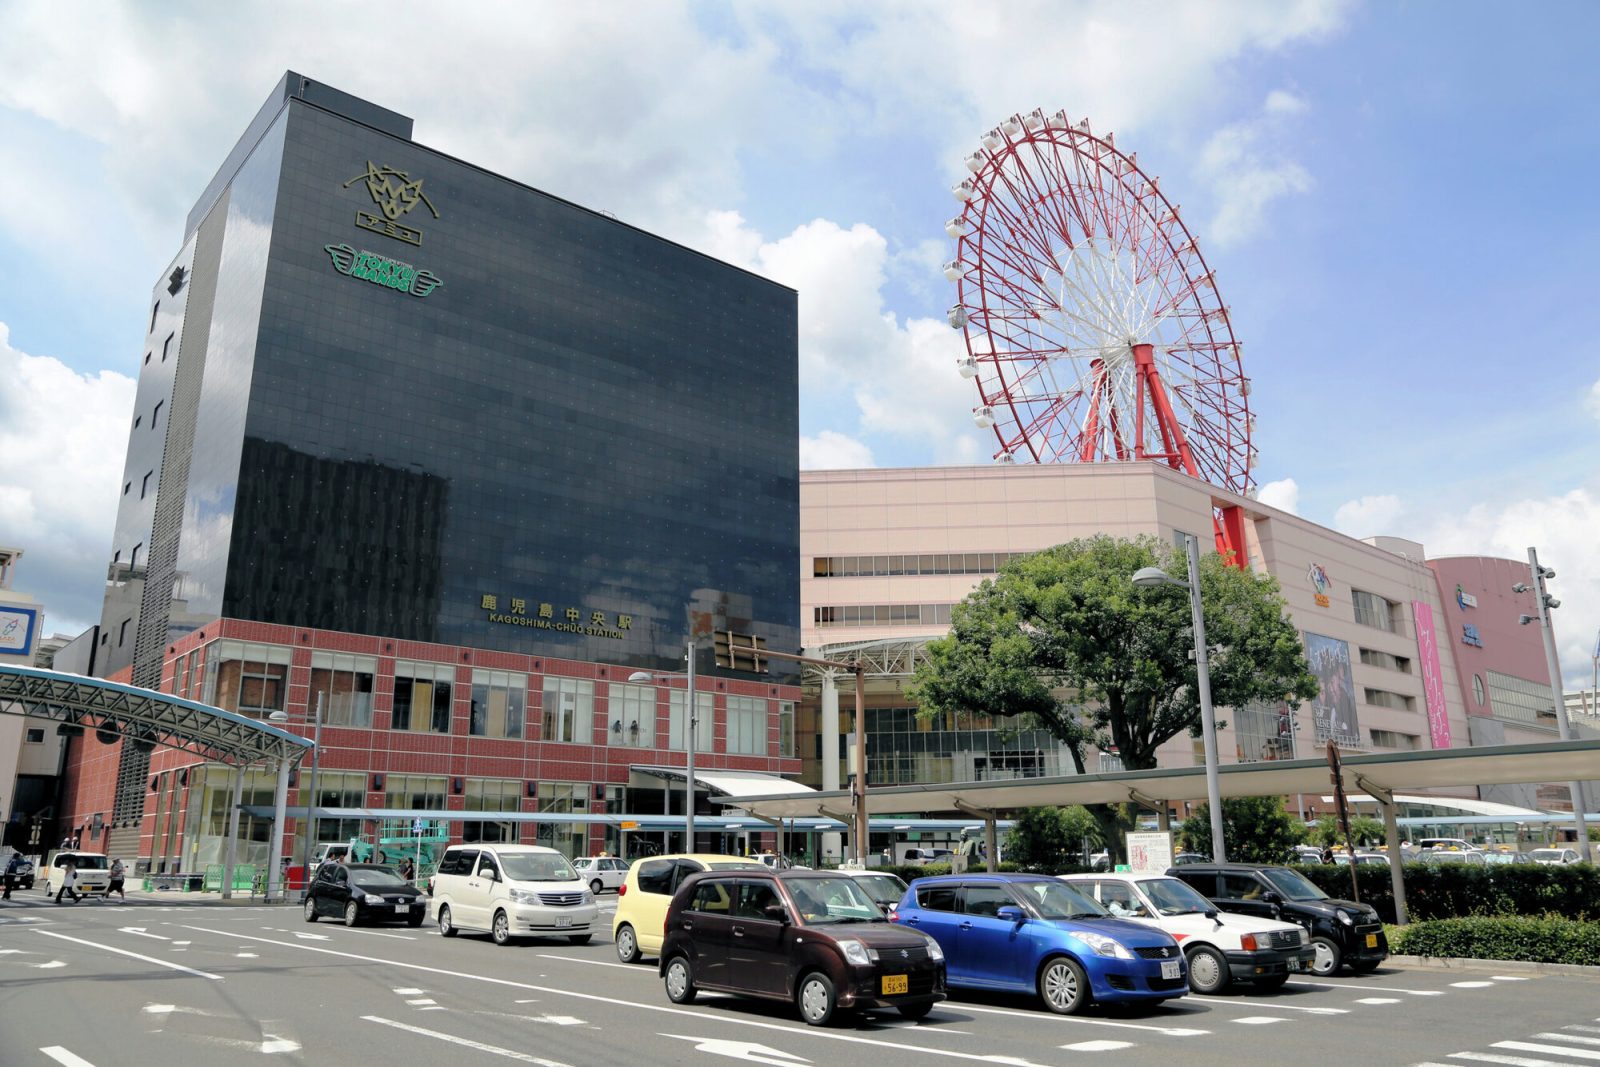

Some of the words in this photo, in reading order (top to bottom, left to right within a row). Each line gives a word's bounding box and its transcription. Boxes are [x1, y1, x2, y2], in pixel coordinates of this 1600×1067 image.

[353, 265, 411, 292] HANDS
[358, 253, 415, 281] TOKYU
[481, 594, 633, 631] 鹿児島中央駅
[585, 627, 625, 640] STATION
[887, 982, 907, 993] 56-99
